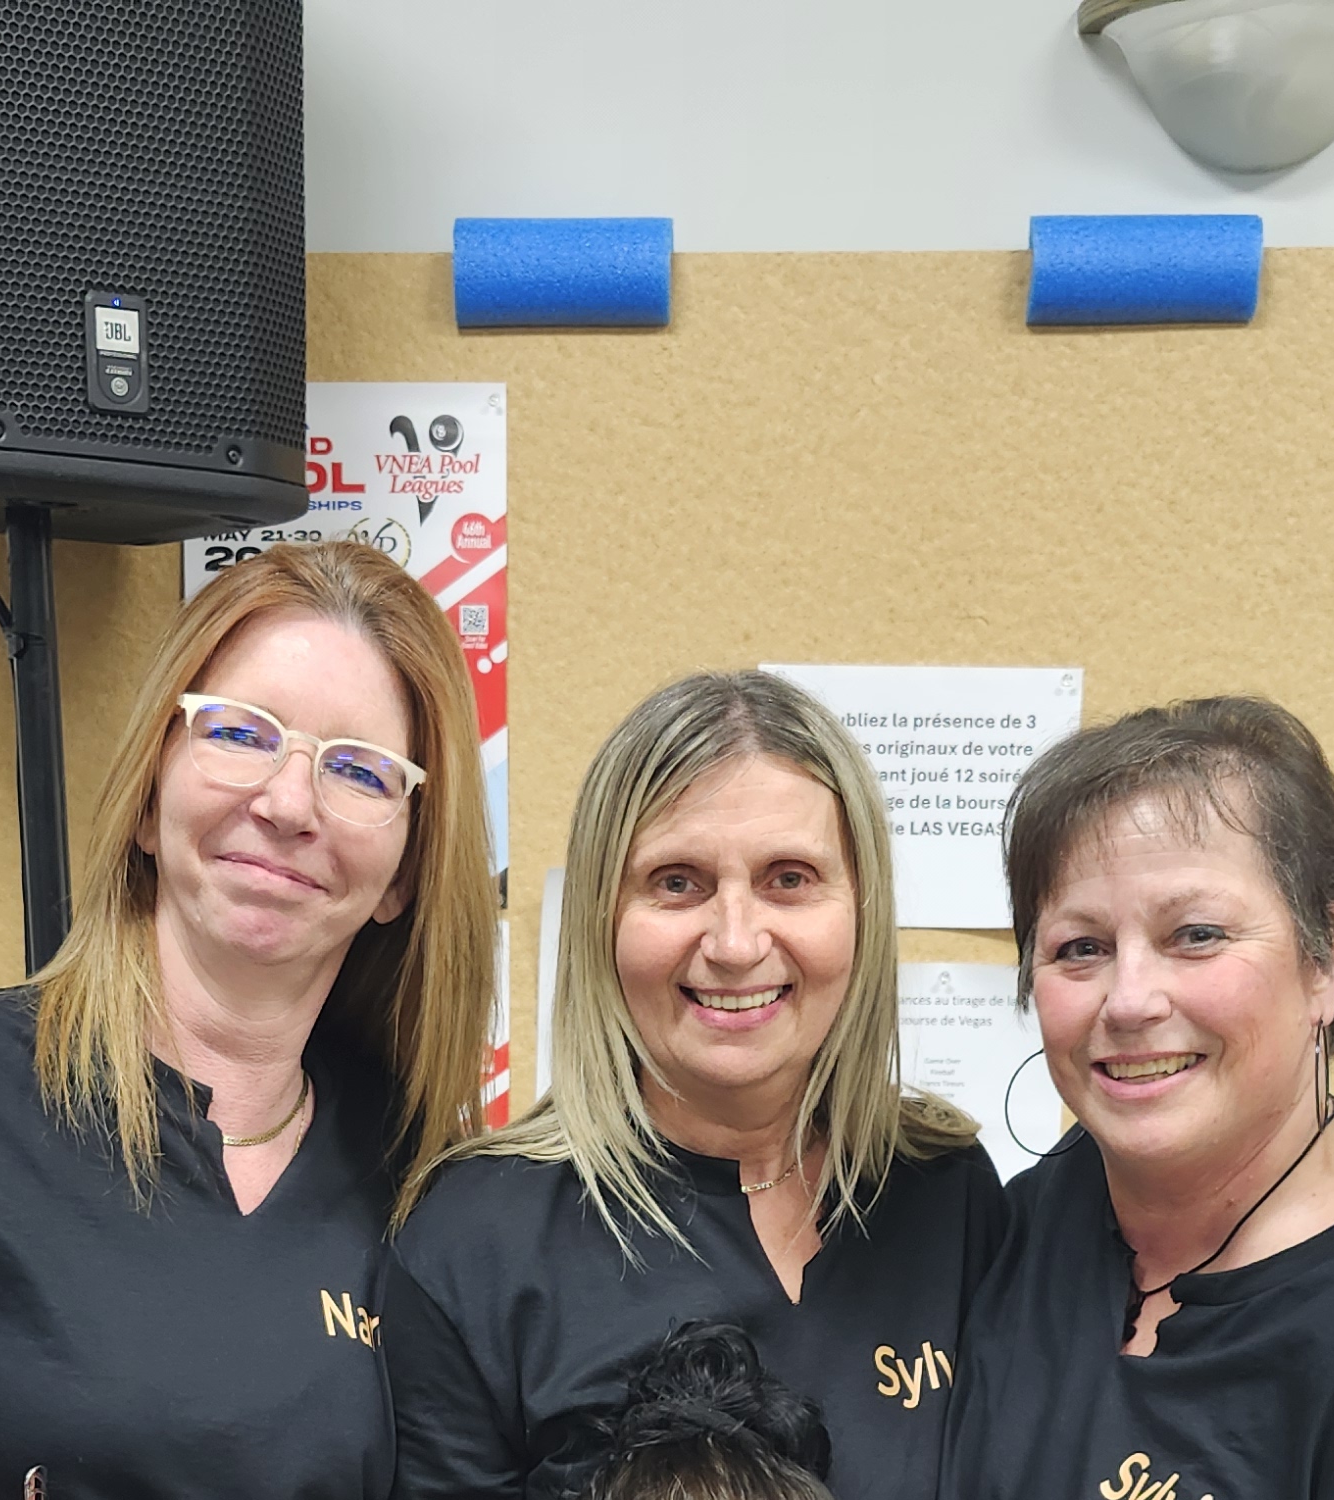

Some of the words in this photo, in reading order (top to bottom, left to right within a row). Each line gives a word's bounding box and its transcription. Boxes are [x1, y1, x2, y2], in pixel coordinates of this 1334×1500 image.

[104, 321, 131, 342] JBL
[374, 454, 433, 474] VNEA
[438, 453, 481, 474] Pool
[388, 474, 465, 500] Leagues
[261, 530, 322, 542] 21-30
[204, 546, 262, 571] 20
[893, 713, 908, 728] la
[913, 713, 994, 732] présence
[1000, 714, 1022, 729] de
[1026, 714, 1037, 729] 3
[876, 740, 958, 759] originaux
[962, 742, 984, 756] de
[988, 743, 1034, 757] votre
[876, 769, 907, 782] ant
[910, 768, 949, 786] joué
[954, 769, 974, 783] 12
[909, 795, 931, 809] de
[935, 795, 951, 810] la
[956, 795, 1005, 811] bours
[910, 821, 943, 836] LAS
[934, 998, 950, 1007] au
[952, 996, 987, 1009] tirage
[989, 995, 1005, 1007] de
[940, 1015, 956, 1026] de
[958, 1015, 993, 1029] Vegas
